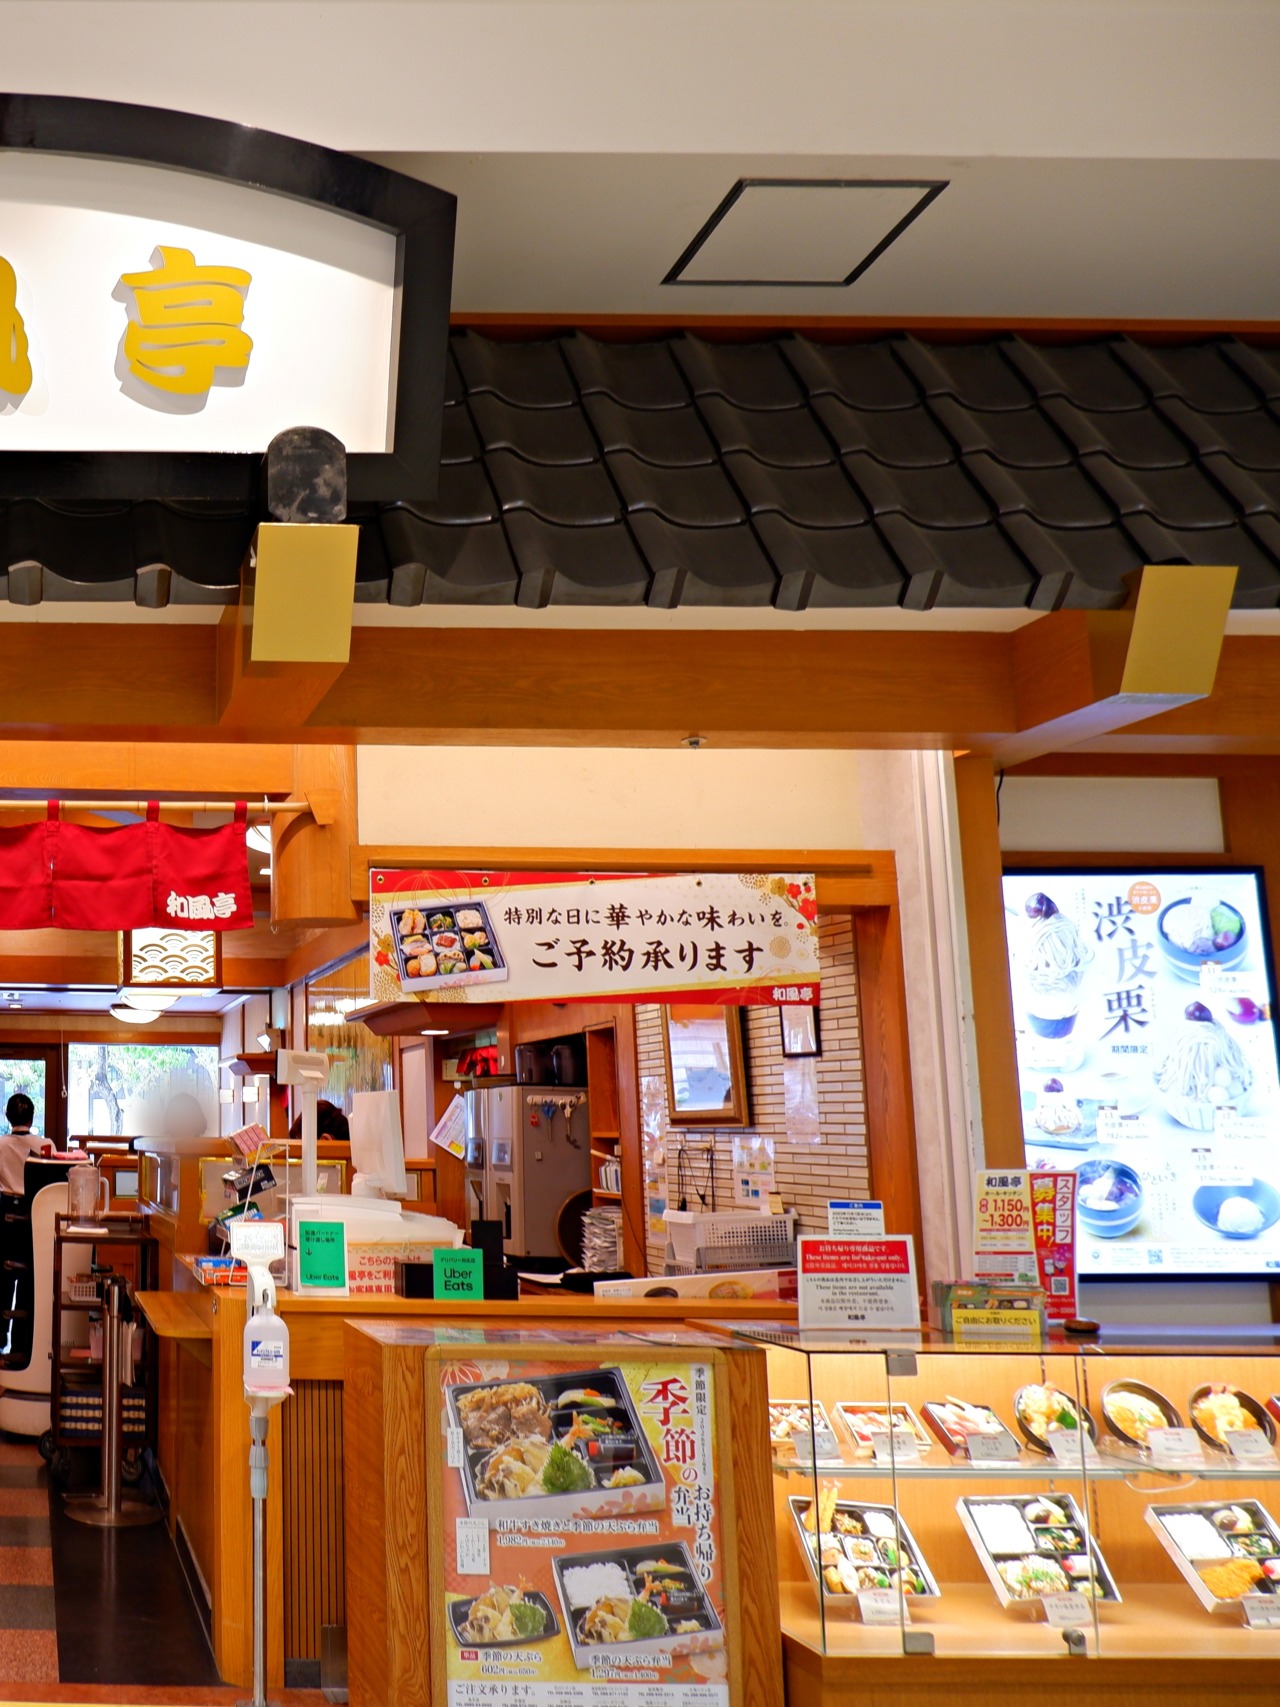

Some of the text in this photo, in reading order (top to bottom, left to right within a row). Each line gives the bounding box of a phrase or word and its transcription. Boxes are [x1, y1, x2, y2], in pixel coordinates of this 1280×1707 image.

[167, 891, 237, 919] 和風亭
[504, 903, 788, 931] 特別な日に華やかな味わいを。
[532, 939, 764, 973] ご予約承ります
[1092, 896, 1157, 1041] 渋皮栗
[772, 987, 813, 1002] 和風亭
[1111, 1045, 1149, 1055] 期間限定
[986, 1176, 1022, 1188] 和風亭
[1057, 1178, 1071, 1241] スタッフ
[444, 1268, 473, 1279] Uber
[444, 1281, 473, 1291] Eats
[956, 1316, 1037, 1325] ご自由にお取りください
[694, 1367, 707, 1415] 季節限定
[642, 1377, 698, 1482] 季節の
[673, 1487, 692, 1525] 弁当
[498, 1519, 659, 1533] 和牛すき焼きと季節の天ぷら弁当
[694, 1485, 713, 1581] お持ち帰り
[482, 1651, 541, 1661] 季節の天ぷら
[591, 1655, 672, 1667] 季節の天ぷら弁当
[455, 1683, 535, 1696] ご注文承ります。
